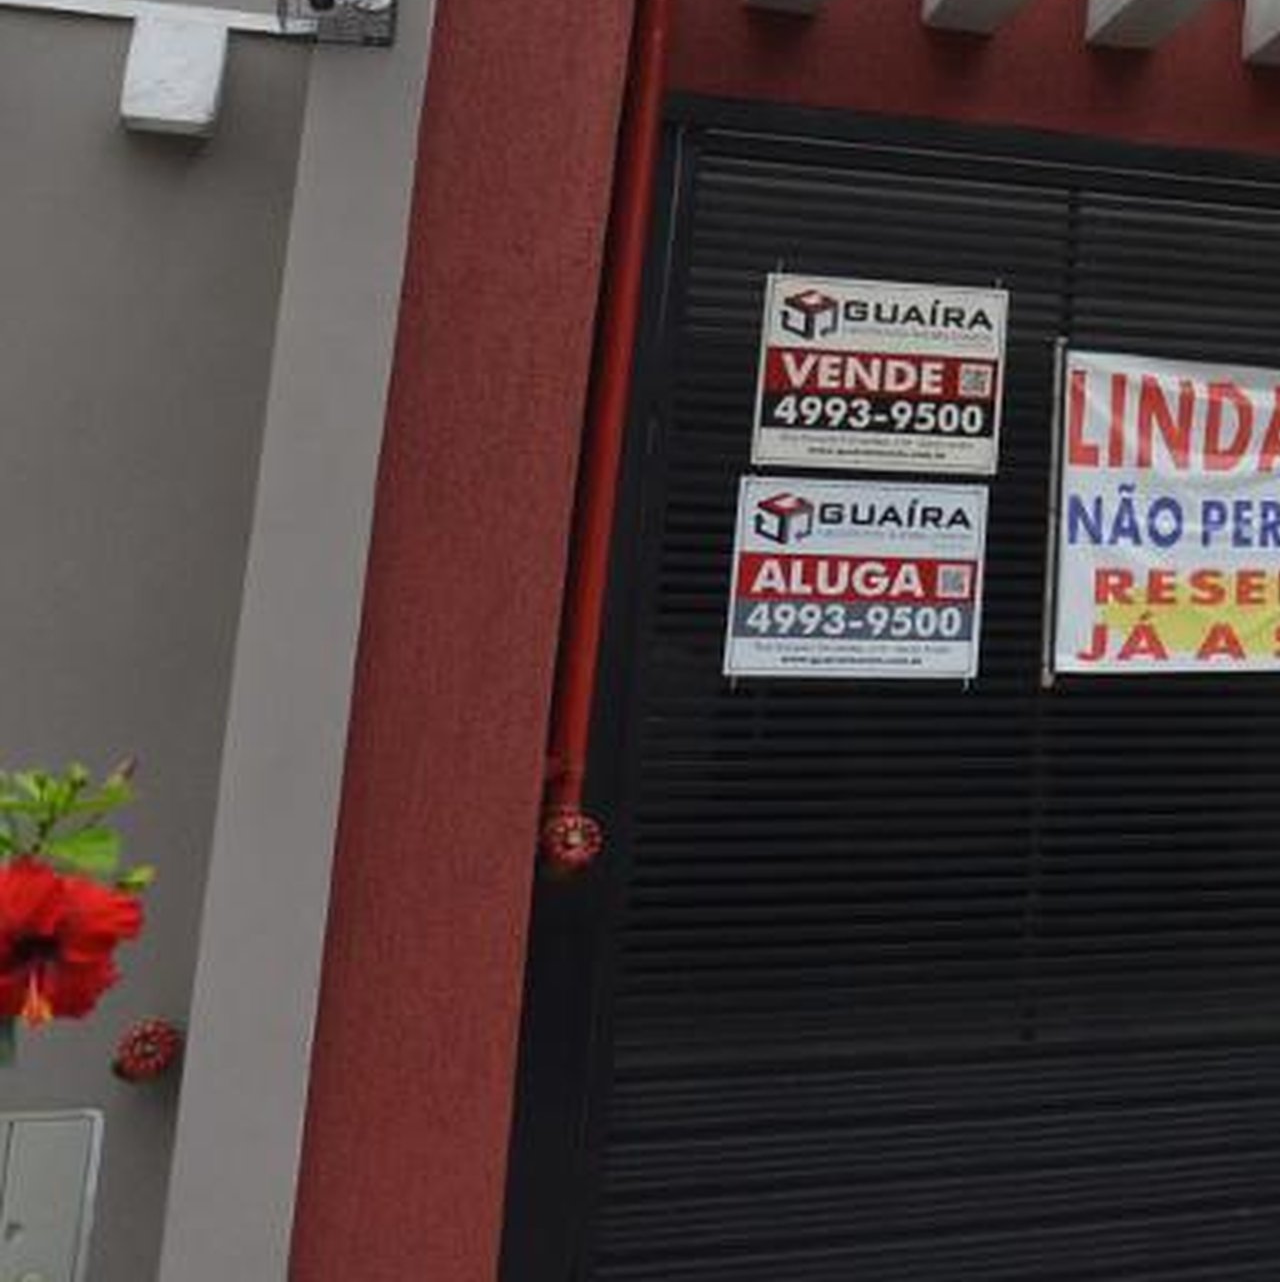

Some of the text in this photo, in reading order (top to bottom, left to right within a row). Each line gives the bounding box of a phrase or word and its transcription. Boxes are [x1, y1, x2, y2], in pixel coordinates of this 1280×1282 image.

[843, 299, 994, 331] GUAÍRA
[781, 352, 945, 395] VENDE
[773, 395, 984, 434] 4993-9500
[818, 498, 973, 530] GUAÍRA
[1067, 482, 1184, 549] NÃO
[751, 558, 925, 598] ALUGA
[746, 603, 962, 637] 4993-9500
[1075, 610, 1169, 662] JÁ
[1195, 620, 1247, 660] A
